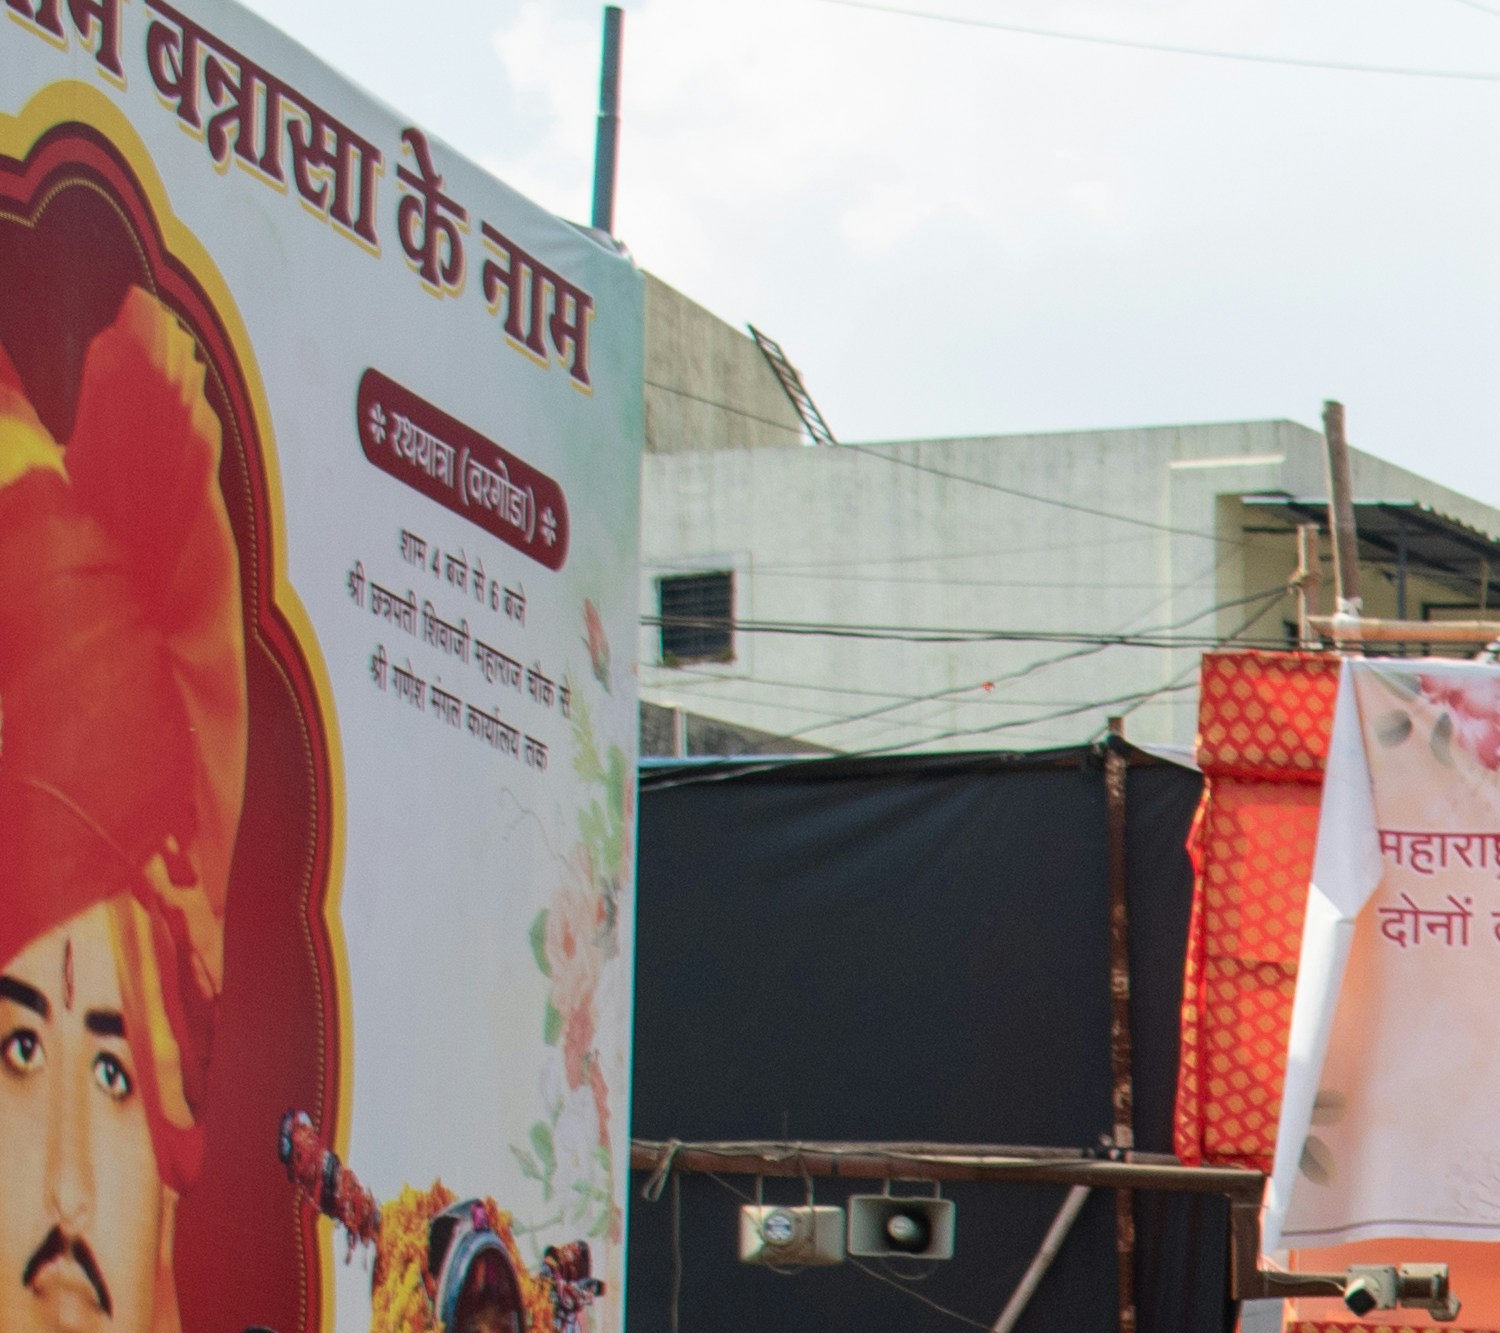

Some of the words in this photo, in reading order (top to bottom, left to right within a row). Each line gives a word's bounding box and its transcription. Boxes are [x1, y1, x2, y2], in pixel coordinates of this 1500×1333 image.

[397, 127, 468, 290] के
[481, 221, 594, 392] नाम
[391, 411, 456, 489] रथयात्रा
[348, 560, 366, 608] श्री
[422, 600, 471, 665] शिवाजी
[475, 638, 524, 694] महाराज
[401, 527, 428, 572] शाम
[431, 547, 442, 579] 4
[446, 547, 469, 595] बजे
[472, 557, 486, 605] से
[490, 579, 500, 613] 6
[503, 581, 528, 628] बजे
[371, 643, 388, 692] श्री
[393, 657, 426, 712] गणेश
[430, 675, 463, 730] मंगल
[524, 734, 549, 772] तक
[1379, 893, 1473, 949] दोनों
